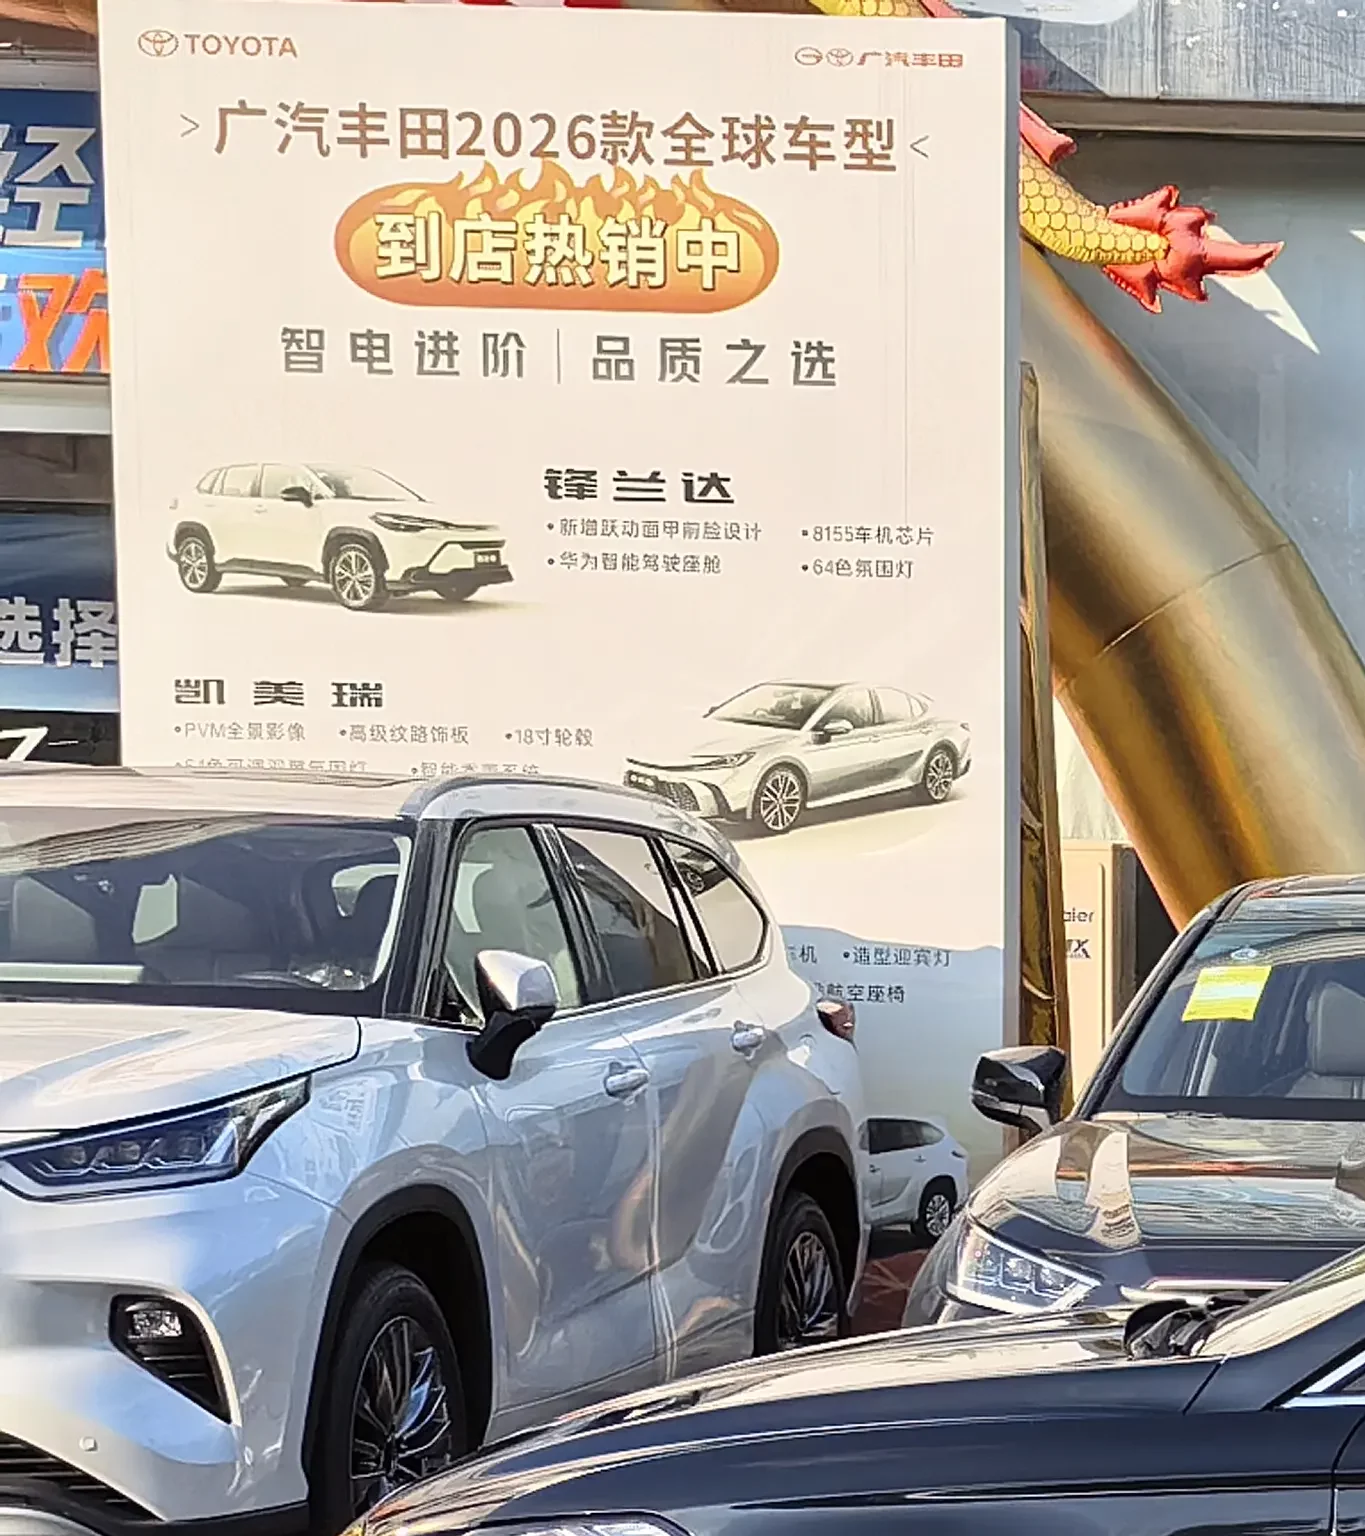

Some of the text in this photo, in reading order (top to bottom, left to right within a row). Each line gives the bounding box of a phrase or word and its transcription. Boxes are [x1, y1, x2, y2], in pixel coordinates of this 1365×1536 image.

[184, 32, 298, 58] TOYOTA
[856, 51, 964, 68] 广汽丰田
[213, 99, 897, 172] 广汽丰田2026款全球车型
[374, 211, 743, 292] 到店热销中
[280, 325, 838, 388] 智电进阶 品质之选
[543, 468, 735, 504] 锋兰达
[812, 524, 934, 546] 8155车机芯片
[559, 551, 722, 574] 华为智能驾驶座舱
[812, 558, 915, 580] 64色氛围灯
[0, 596, 118, 668] 选择
[173, 679, 384, 708] 凯美瑞
[184, 722, 306, 742] PVM全景影像
[349, 723, 470, 745] 高级纹路饰板
[514, 727, 594, 748] 18寸轮毂
[1063, 907, 1095, 923] aier
[852, 946, 952, 967] 造型迎宾灯
